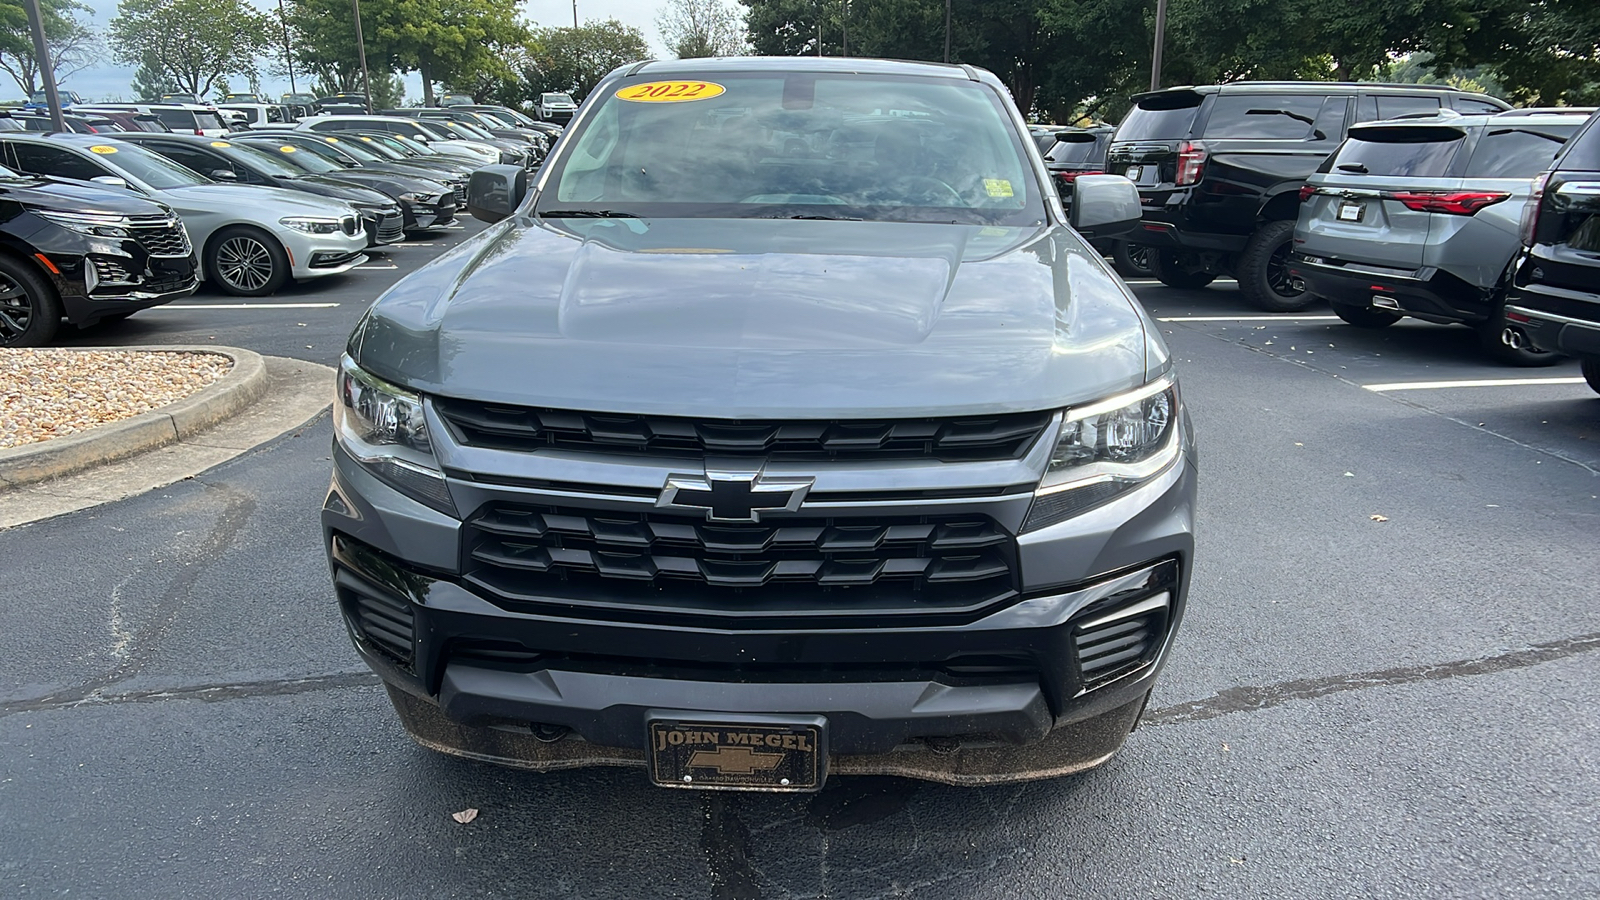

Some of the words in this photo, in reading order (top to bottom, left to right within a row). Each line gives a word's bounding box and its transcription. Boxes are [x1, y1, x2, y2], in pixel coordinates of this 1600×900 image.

[629, 84, 706, 98] 2022
[657, 731, 719, 751] JOHN
[727, 732, 812, 751] MEGEL
